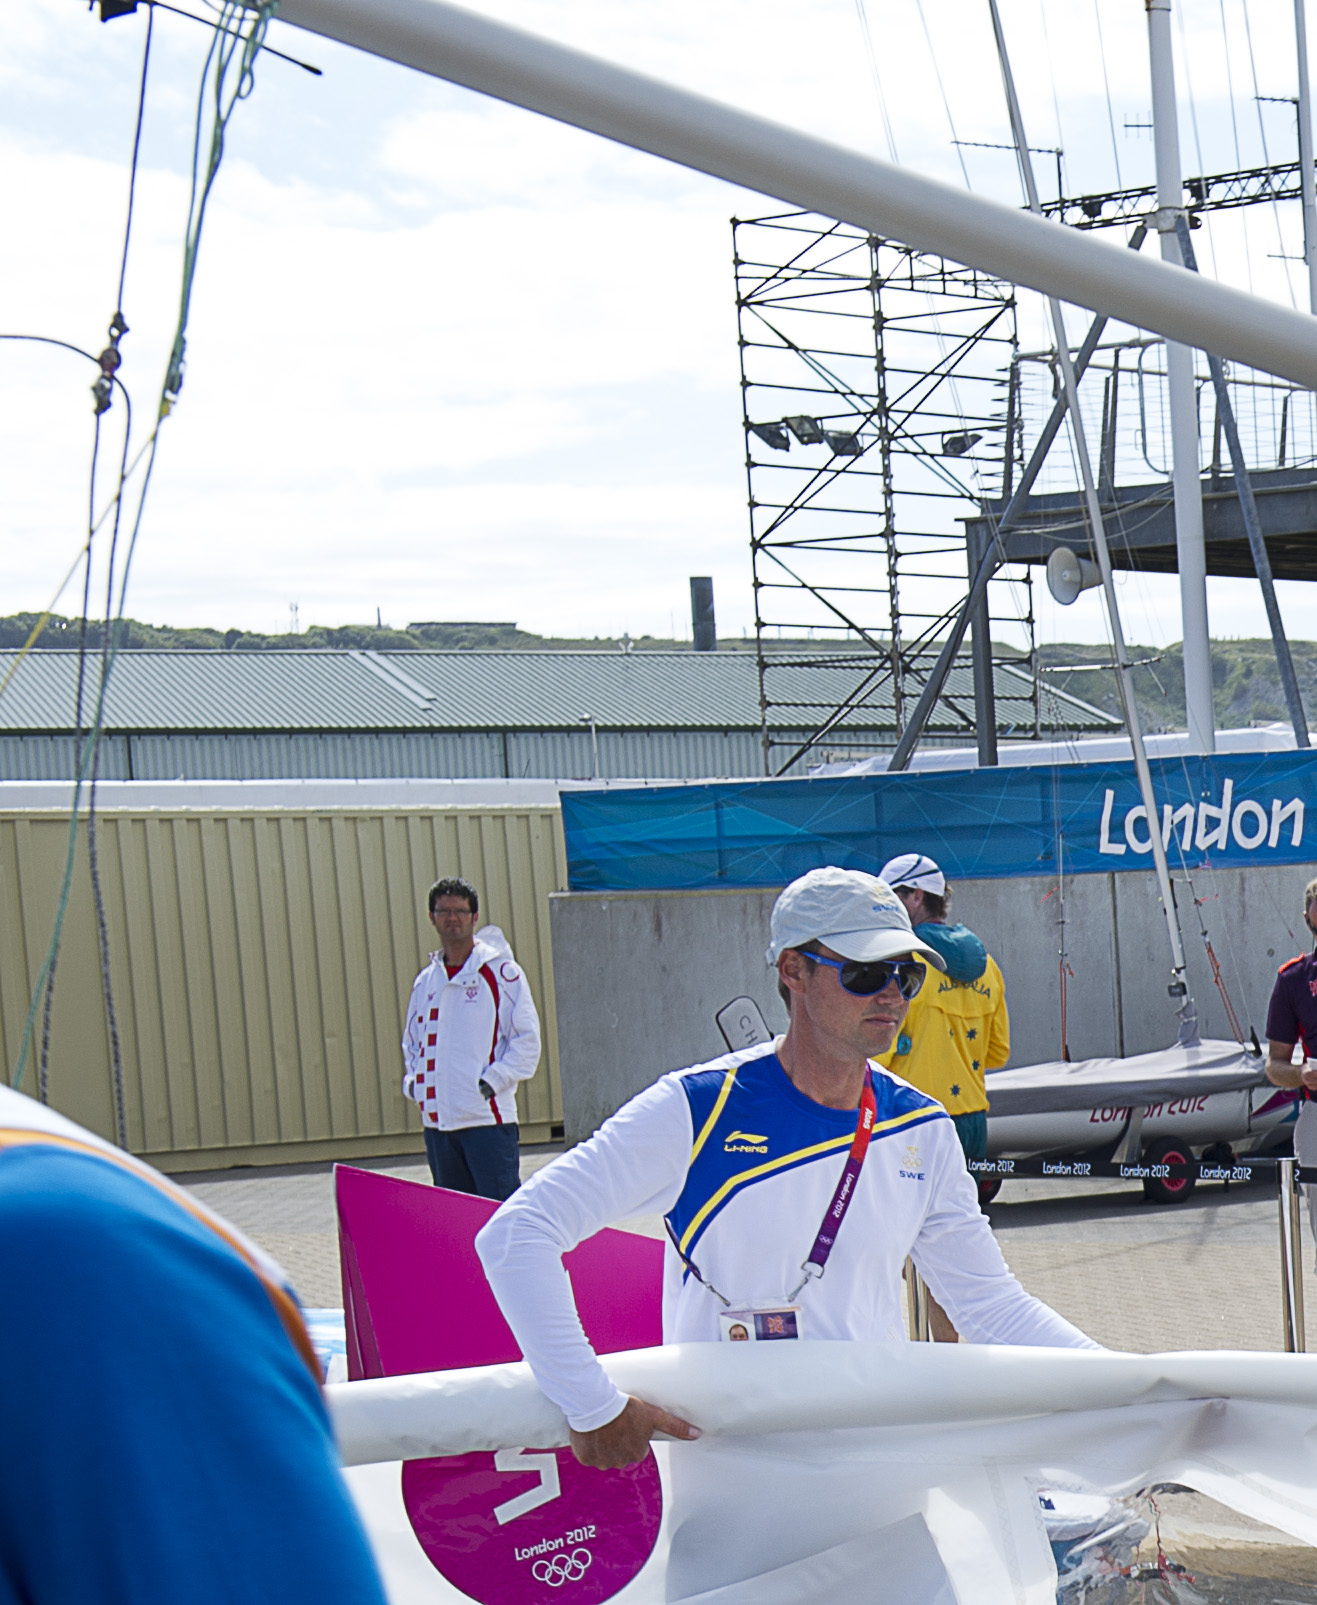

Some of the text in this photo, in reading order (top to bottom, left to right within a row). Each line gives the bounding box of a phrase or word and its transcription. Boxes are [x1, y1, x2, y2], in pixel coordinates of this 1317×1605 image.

[1099, 777, 1305, 855] London
[968, 1158, 1015, 1173] London 2012
[1042, 1161, 1091, 1176] London 2012
[1120, 1163, 1170, 1178] London 2012
[1200, 1165, 1252, 1180] London 2012
[899, 1169, 926, 1181] SWE
[514, 1524, 598, 1562] London 2012
